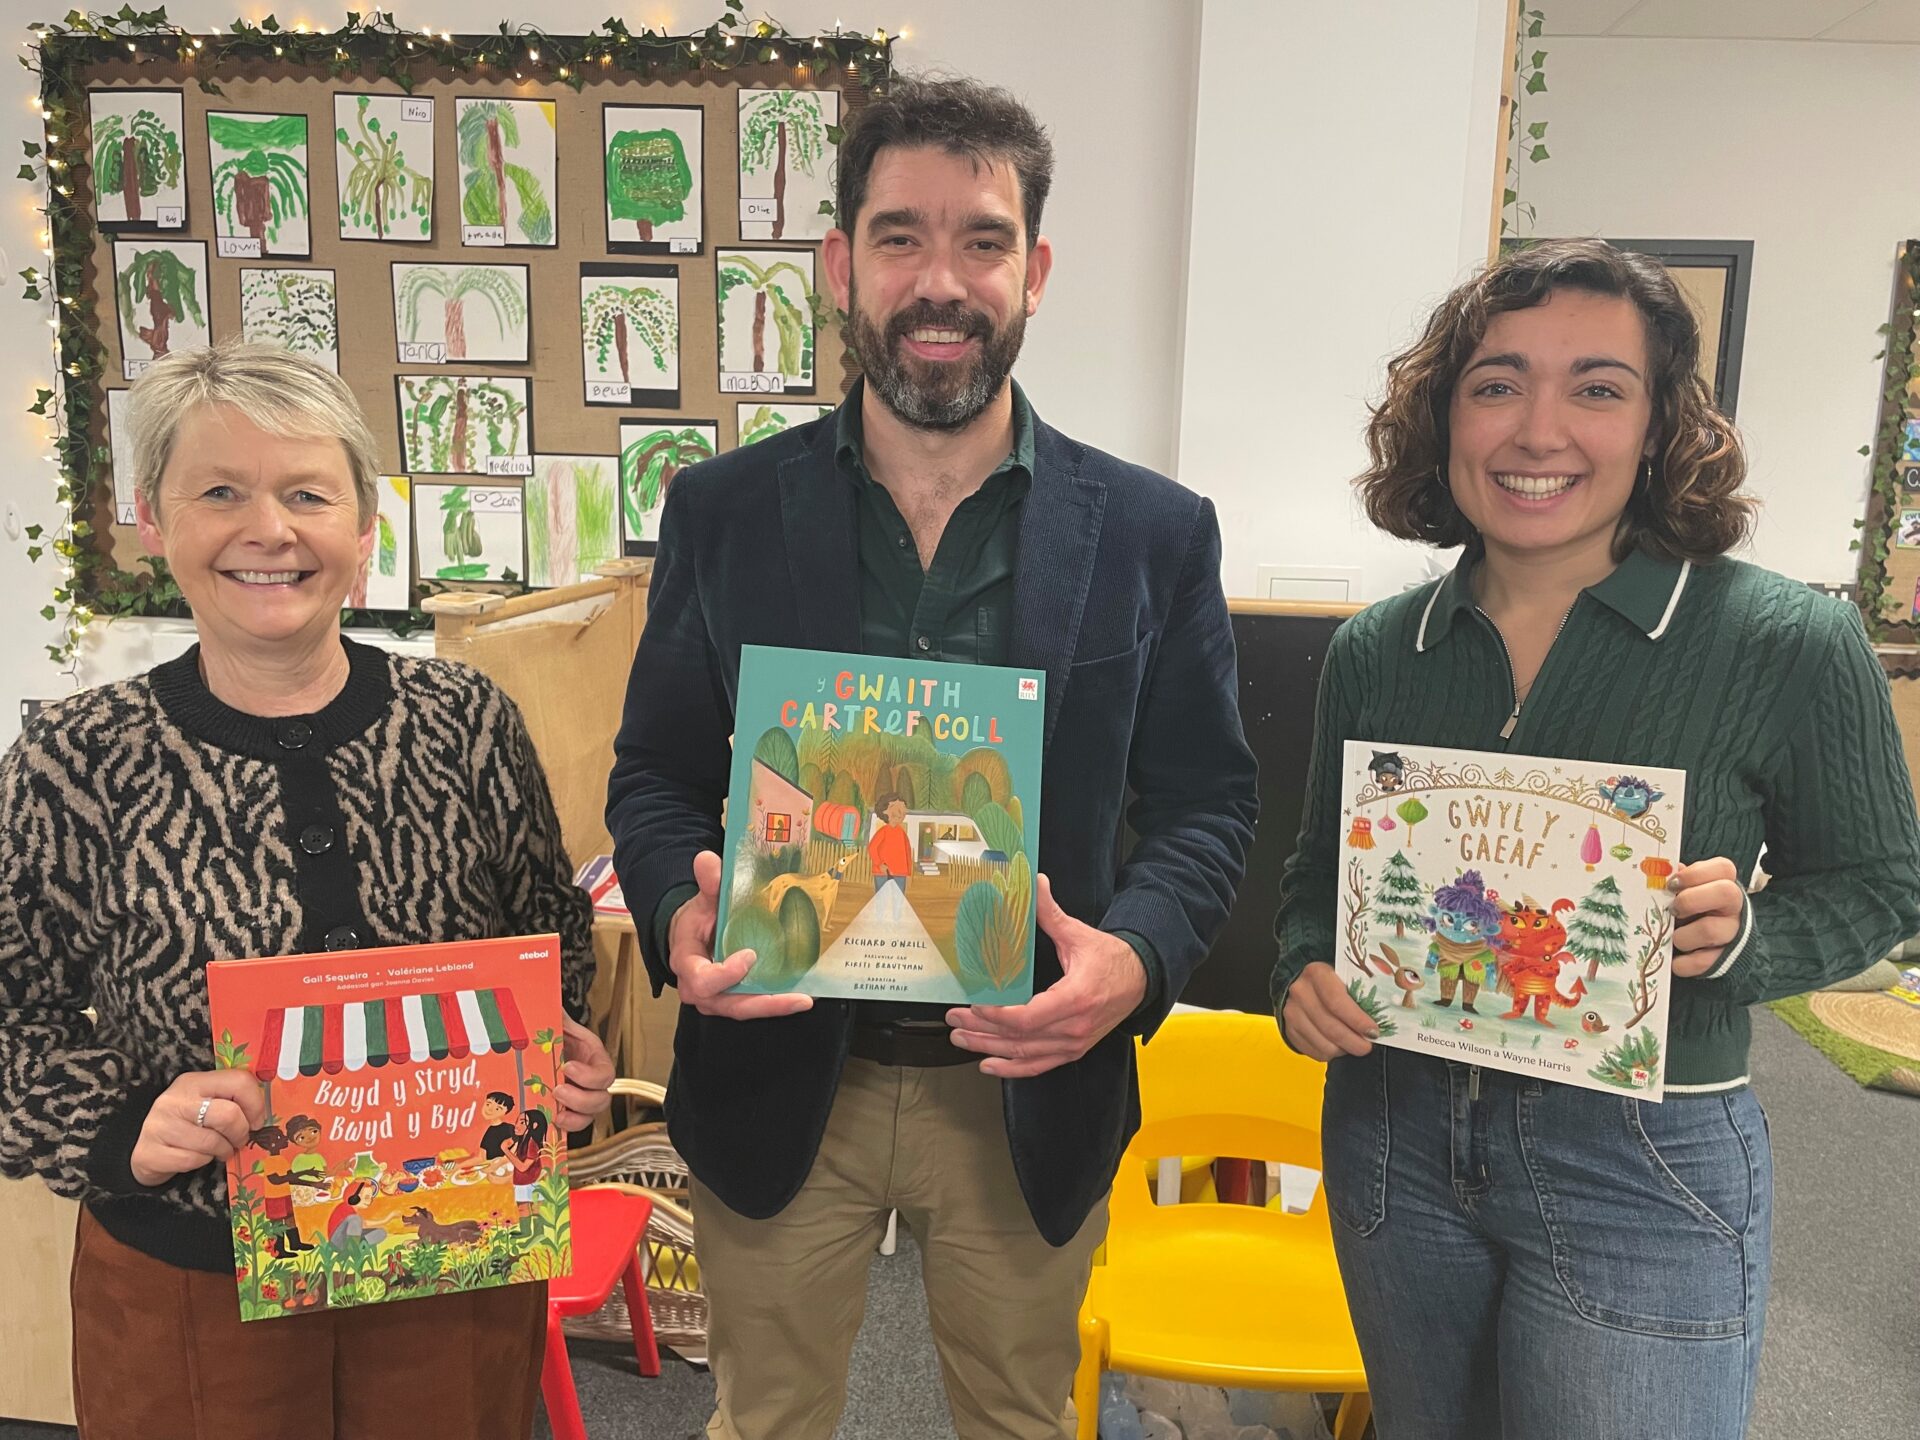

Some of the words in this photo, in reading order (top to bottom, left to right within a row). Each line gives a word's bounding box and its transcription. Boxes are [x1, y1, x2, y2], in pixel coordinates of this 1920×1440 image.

[834, 671, 961, 708] GWAITH
[934, 713, 1003, 743] COLL
[1541, 810, 1561, 839] Y
[1460, 832, 1545, 869] GAEAF
[519, 950, 549, 961] atebol
[844, 937, 886, 947] RICHARD
[302, 974, 324, 985] Gail
[325, 971, 369, 985] Sequeira
[387, 964, 434, 977] Valériane
[436, 961, 475, 974] Leblond
[1417, 1032, 1457, 1049] Rebecca
[1458, 1041, 1492, 1056] Wilson
[1493, 1050, 1500, 1058] a
[1502, 1051, 1537, 1067] Wayne
[1538, 1059, 1572, 1073] Harris
[314, 1079, 381, 1116] Bwyd
[393, 1084, 407, 1112] y
[414, 1059, 482, 1097] Stryd,
[329, 1111, 394, 1147] Bwyd
[408, 1116, 421, 1138] y
[430, 1101, 479, 1136] Byd
